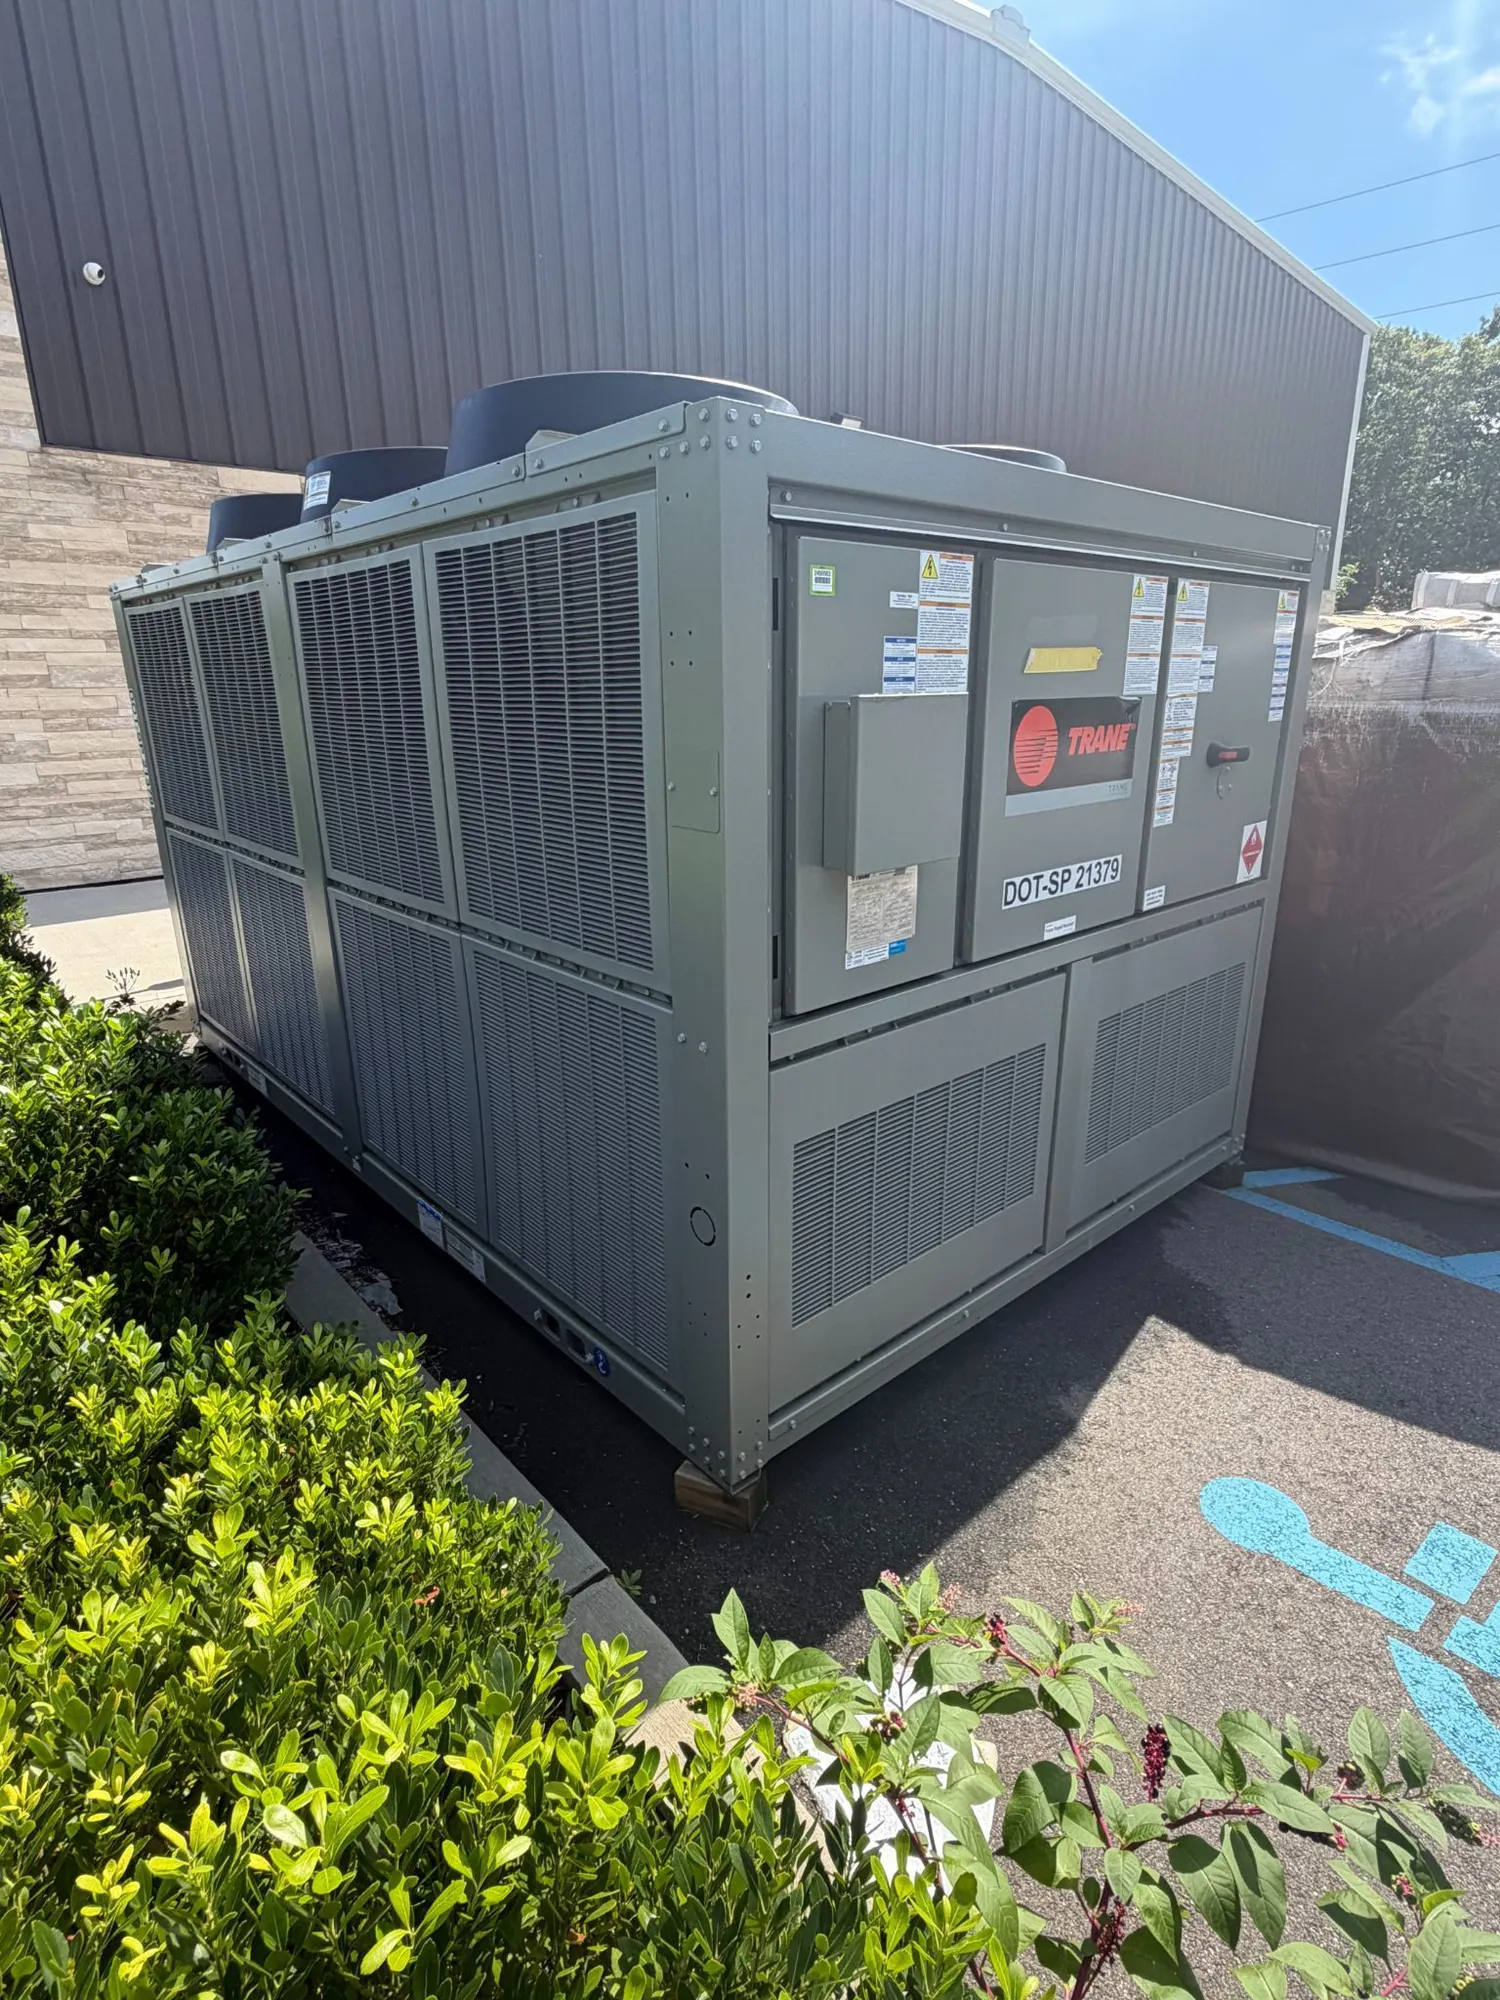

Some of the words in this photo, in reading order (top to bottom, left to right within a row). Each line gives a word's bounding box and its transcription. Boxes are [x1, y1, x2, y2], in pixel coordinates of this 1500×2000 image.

[1067, 724, 1131, 756] TRANE
[1003, 868, 1072, 907] DOT-SP
[1074, 857, 1119, 890] 21379
